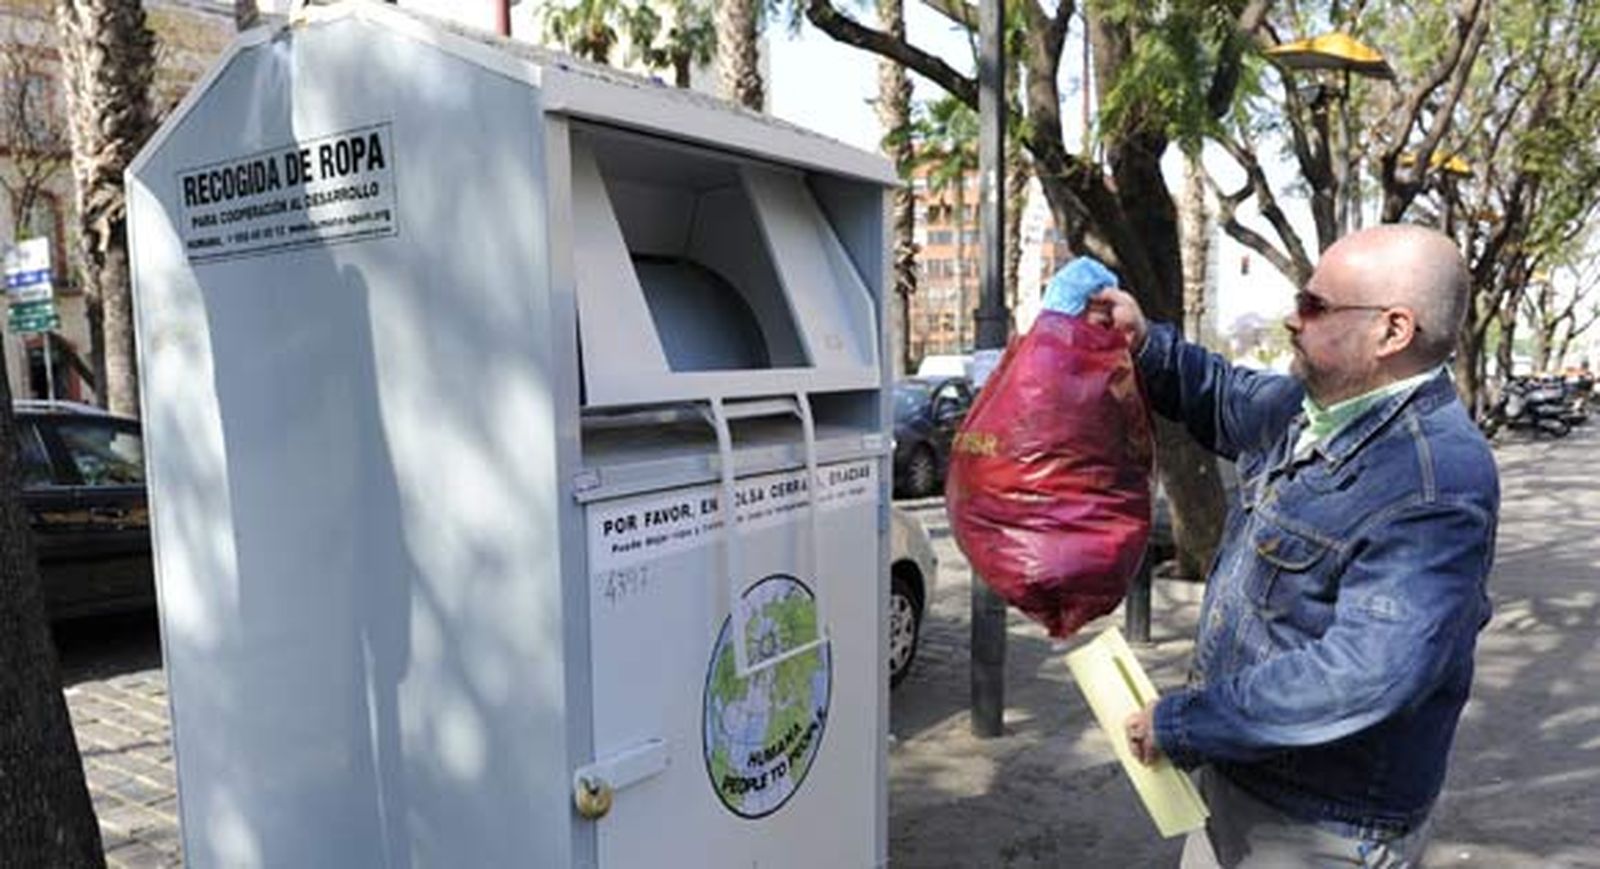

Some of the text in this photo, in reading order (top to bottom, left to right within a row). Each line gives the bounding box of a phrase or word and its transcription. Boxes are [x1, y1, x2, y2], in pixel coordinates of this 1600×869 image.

[183, 131, 386, 208] RECOGIDA DE ROPA
[191, 215, 218, 229] PARA
[288, 198, 304, 211] AL
[304, 181, 380, 208] DESARROLLO
[603, 514, 638, 537] POR
[700, 498, 719, 515] EN
[734, 486, 765, 508] OLSA
[746, 722, 803, 768] HUMANA
[721, 771, 768, 796] PEOPLE
[770, 760, 787, 782] TO
